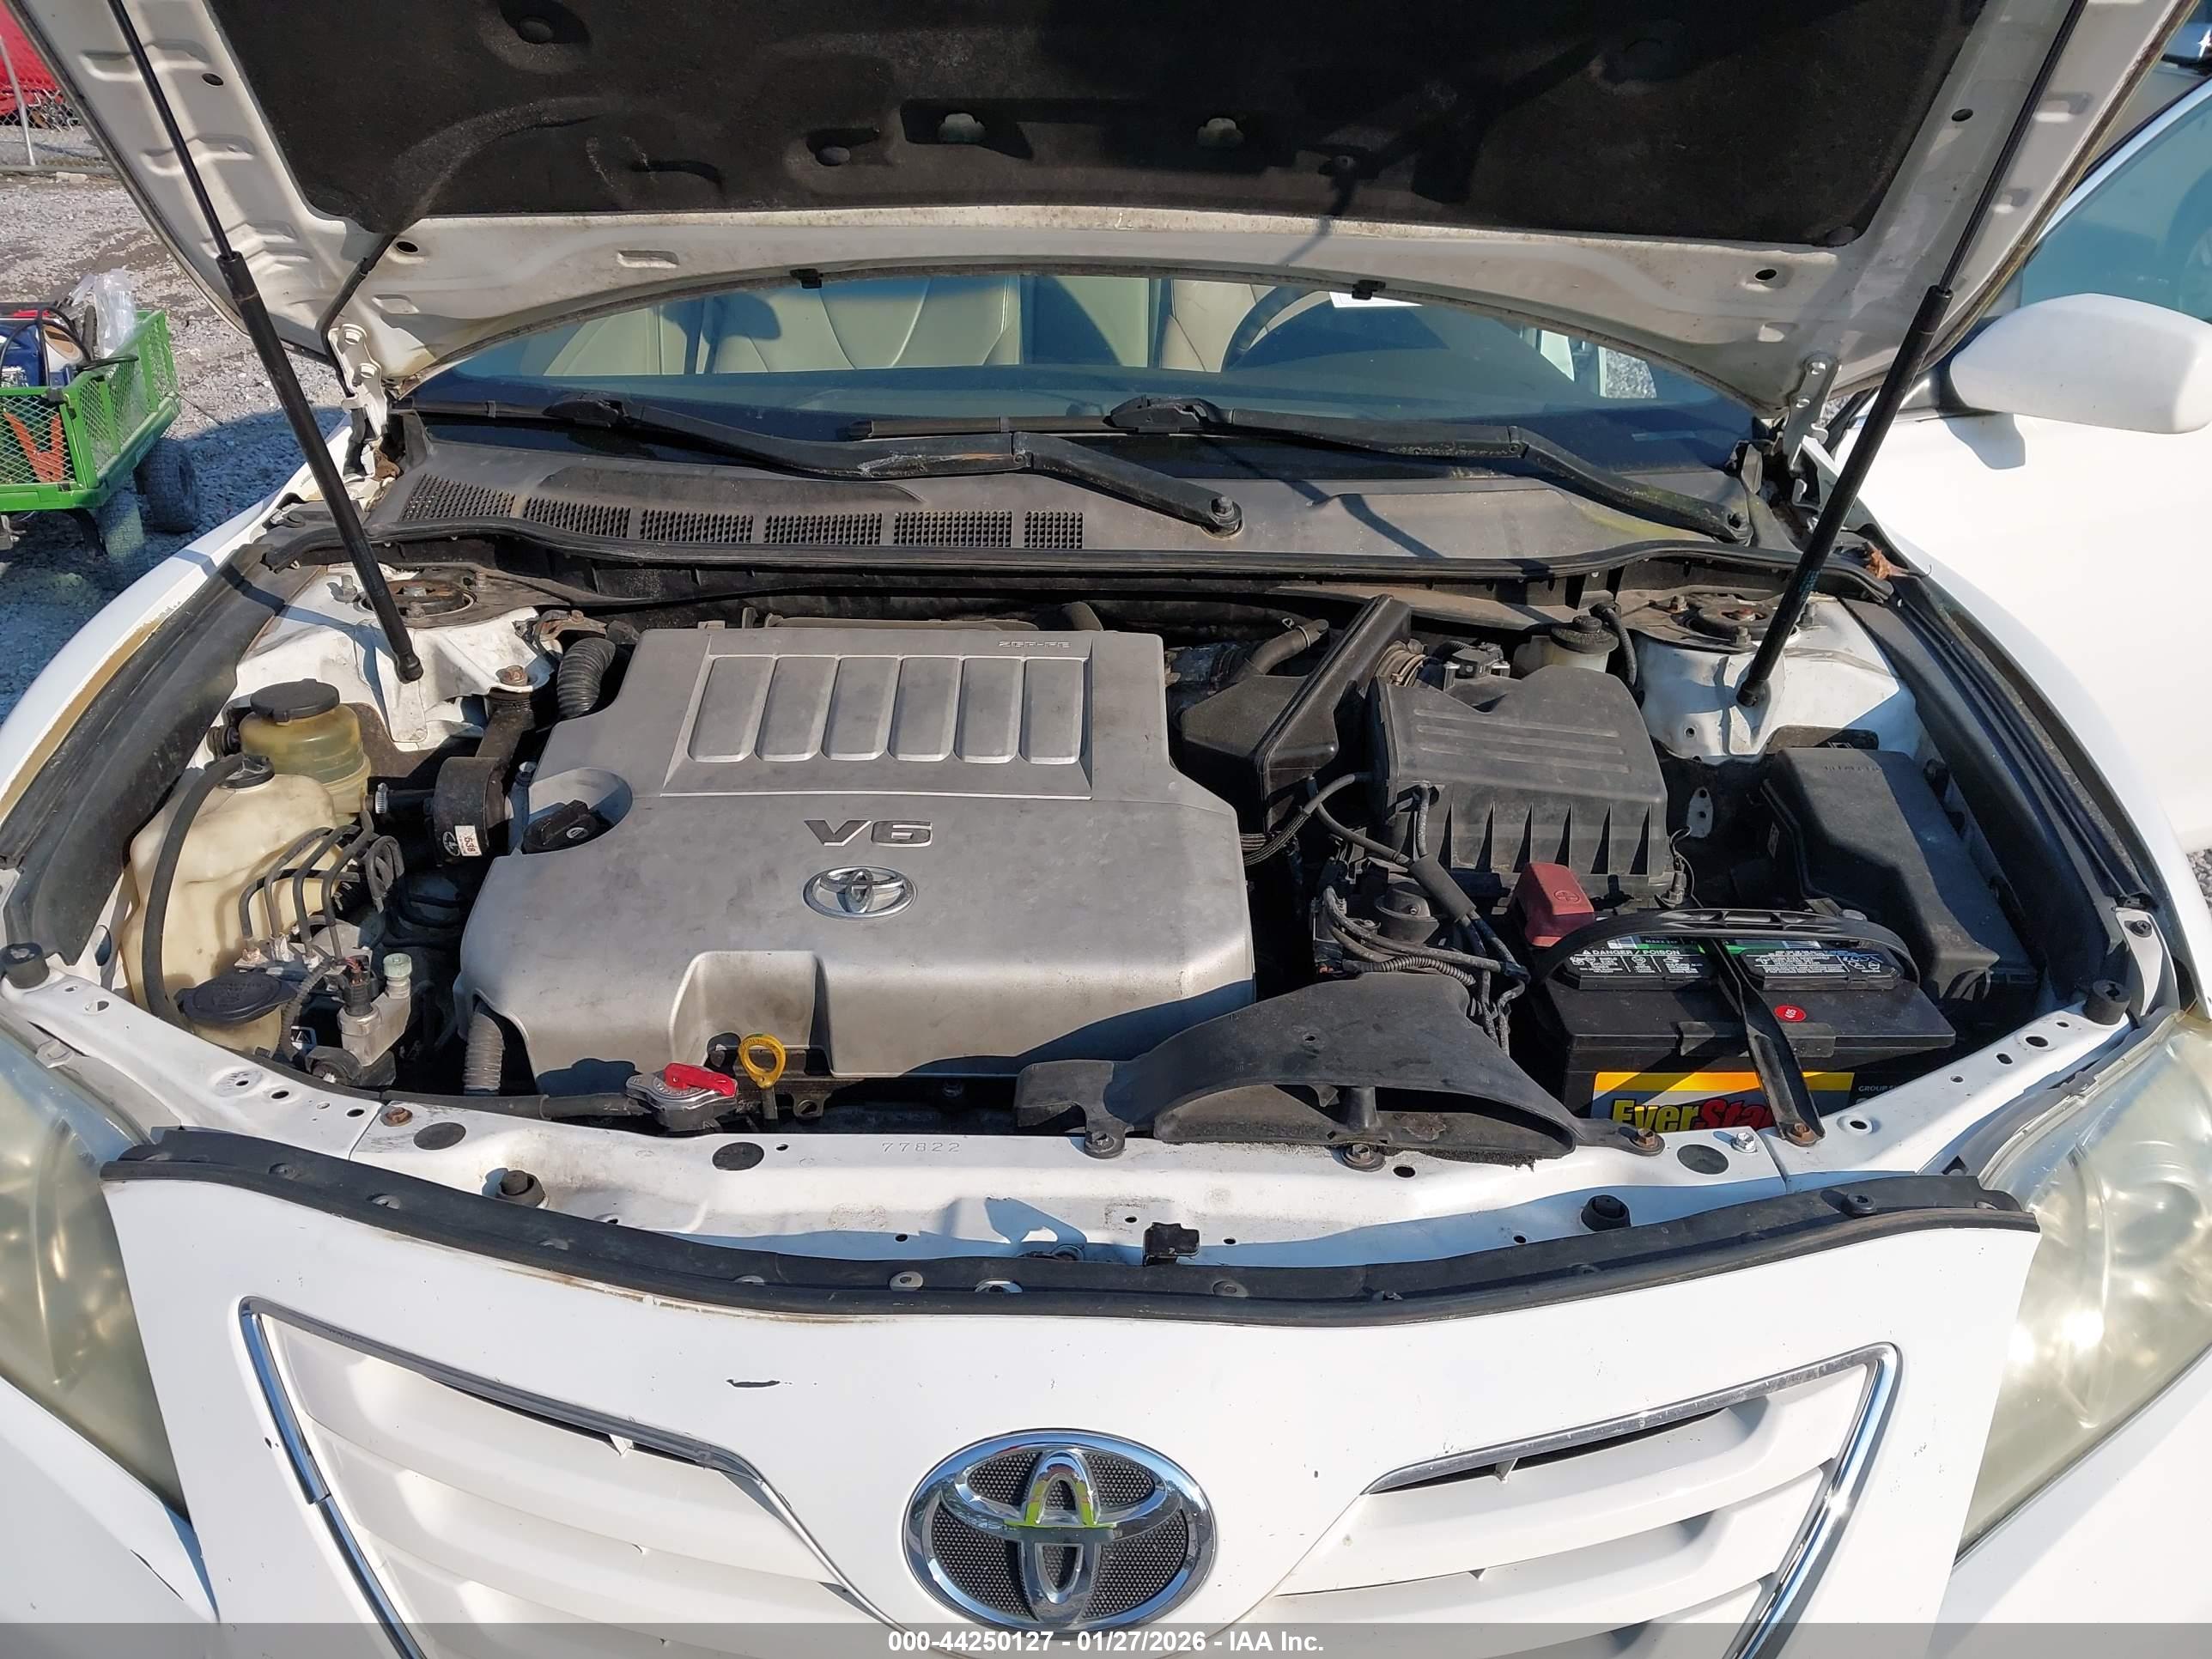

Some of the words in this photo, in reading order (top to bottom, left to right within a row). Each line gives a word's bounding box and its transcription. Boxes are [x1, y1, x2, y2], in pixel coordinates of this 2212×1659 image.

[805, 819, 933, 848] V6
[1612, 1099, 1776, 1133] EverSta
[882, 1142, 960, 1152] 77822
